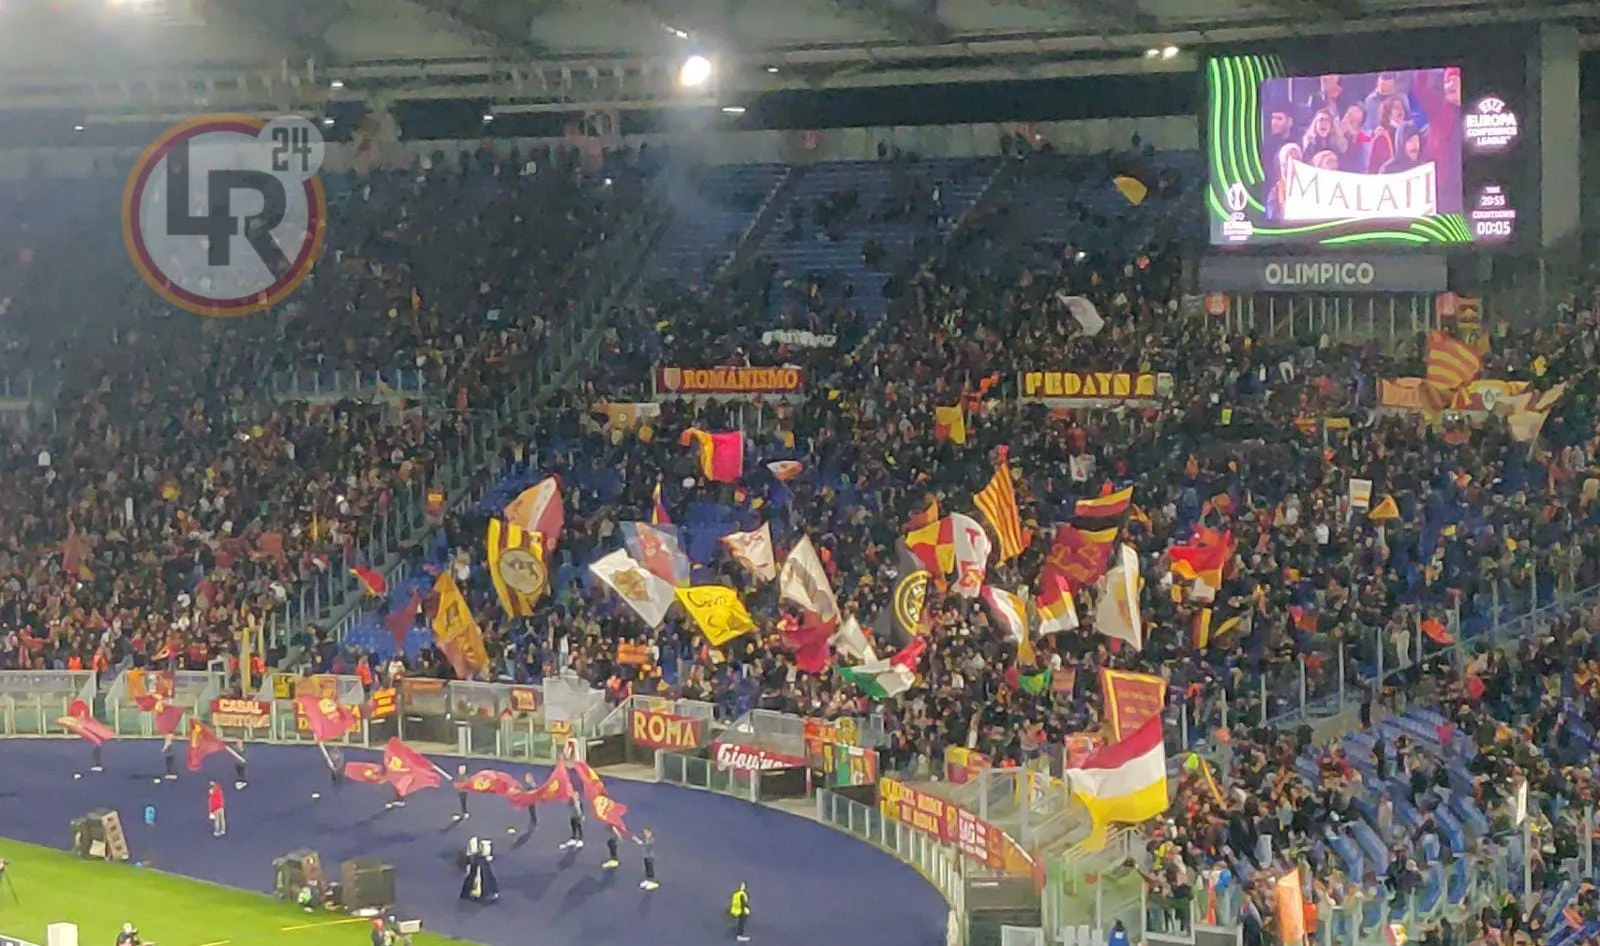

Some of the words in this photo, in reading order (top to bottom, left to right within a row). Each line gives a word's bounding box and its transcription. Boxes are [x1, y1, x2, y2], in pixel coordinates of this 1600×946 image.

[1466, 112, 1518, 128] EUROPA
[1288, 171, 1433, 212] MALATI
[1481, 195, 1506, 206] 20:55
[1477, 221, 1511, 235] 00:05
[1264, 262, 1375, 285] OLIMPICO
[683, 369, 799, 389] ROMANISMO
[633, 710, 697, 748] ROMA
